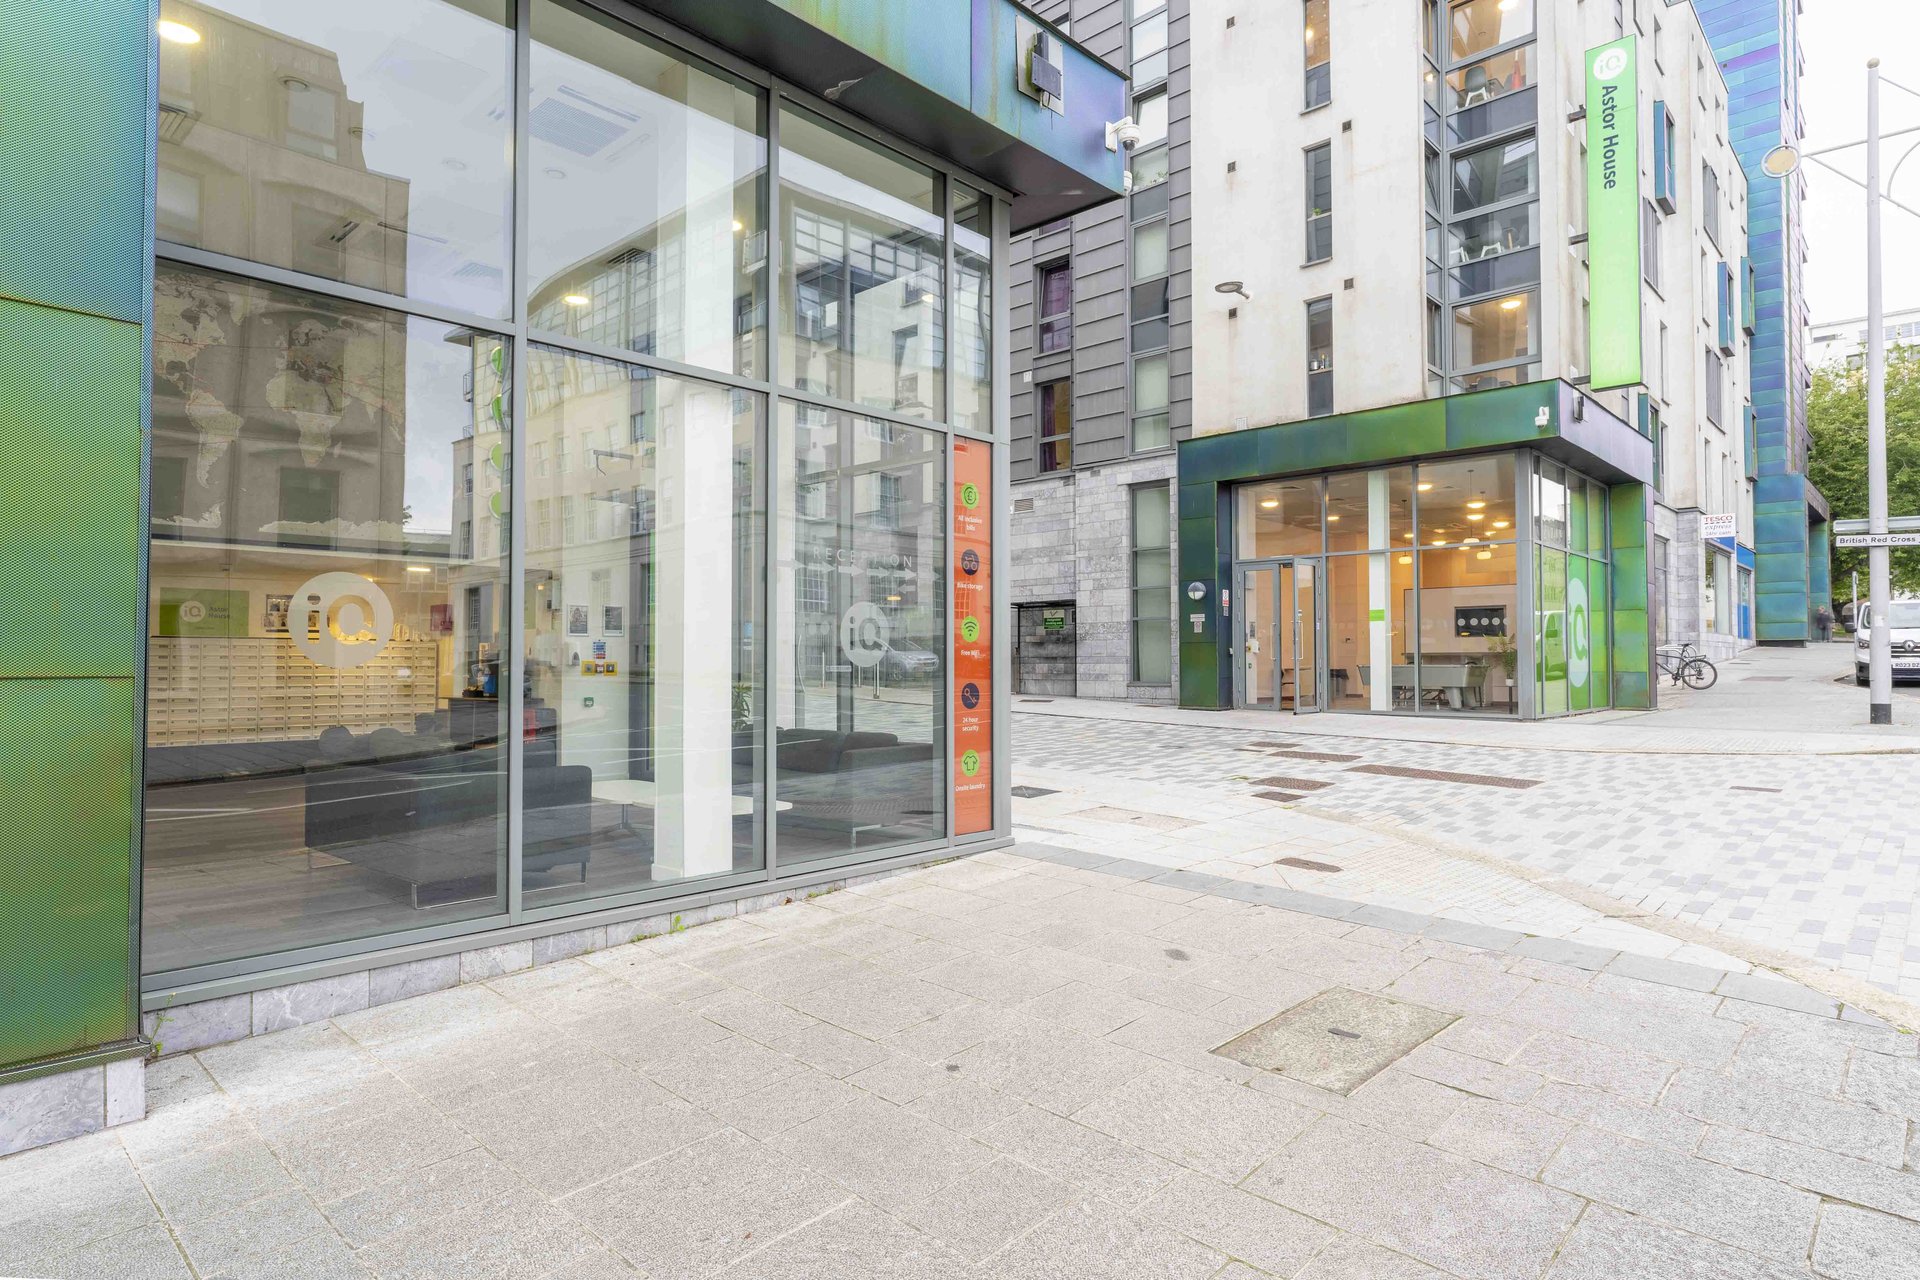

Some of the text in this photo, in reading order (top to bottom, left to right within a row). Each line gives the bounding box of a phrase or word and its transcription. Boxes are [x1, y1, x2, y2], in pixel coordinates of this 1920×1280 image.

[1602, 85, 1619, 190] Astor House
[1839, 537, 1867, 545] British
[813, 547, 912, 567] RECEPTION
[962, 724, 979, 732] security
[955, 783, 985, 792] Onsite laundry
